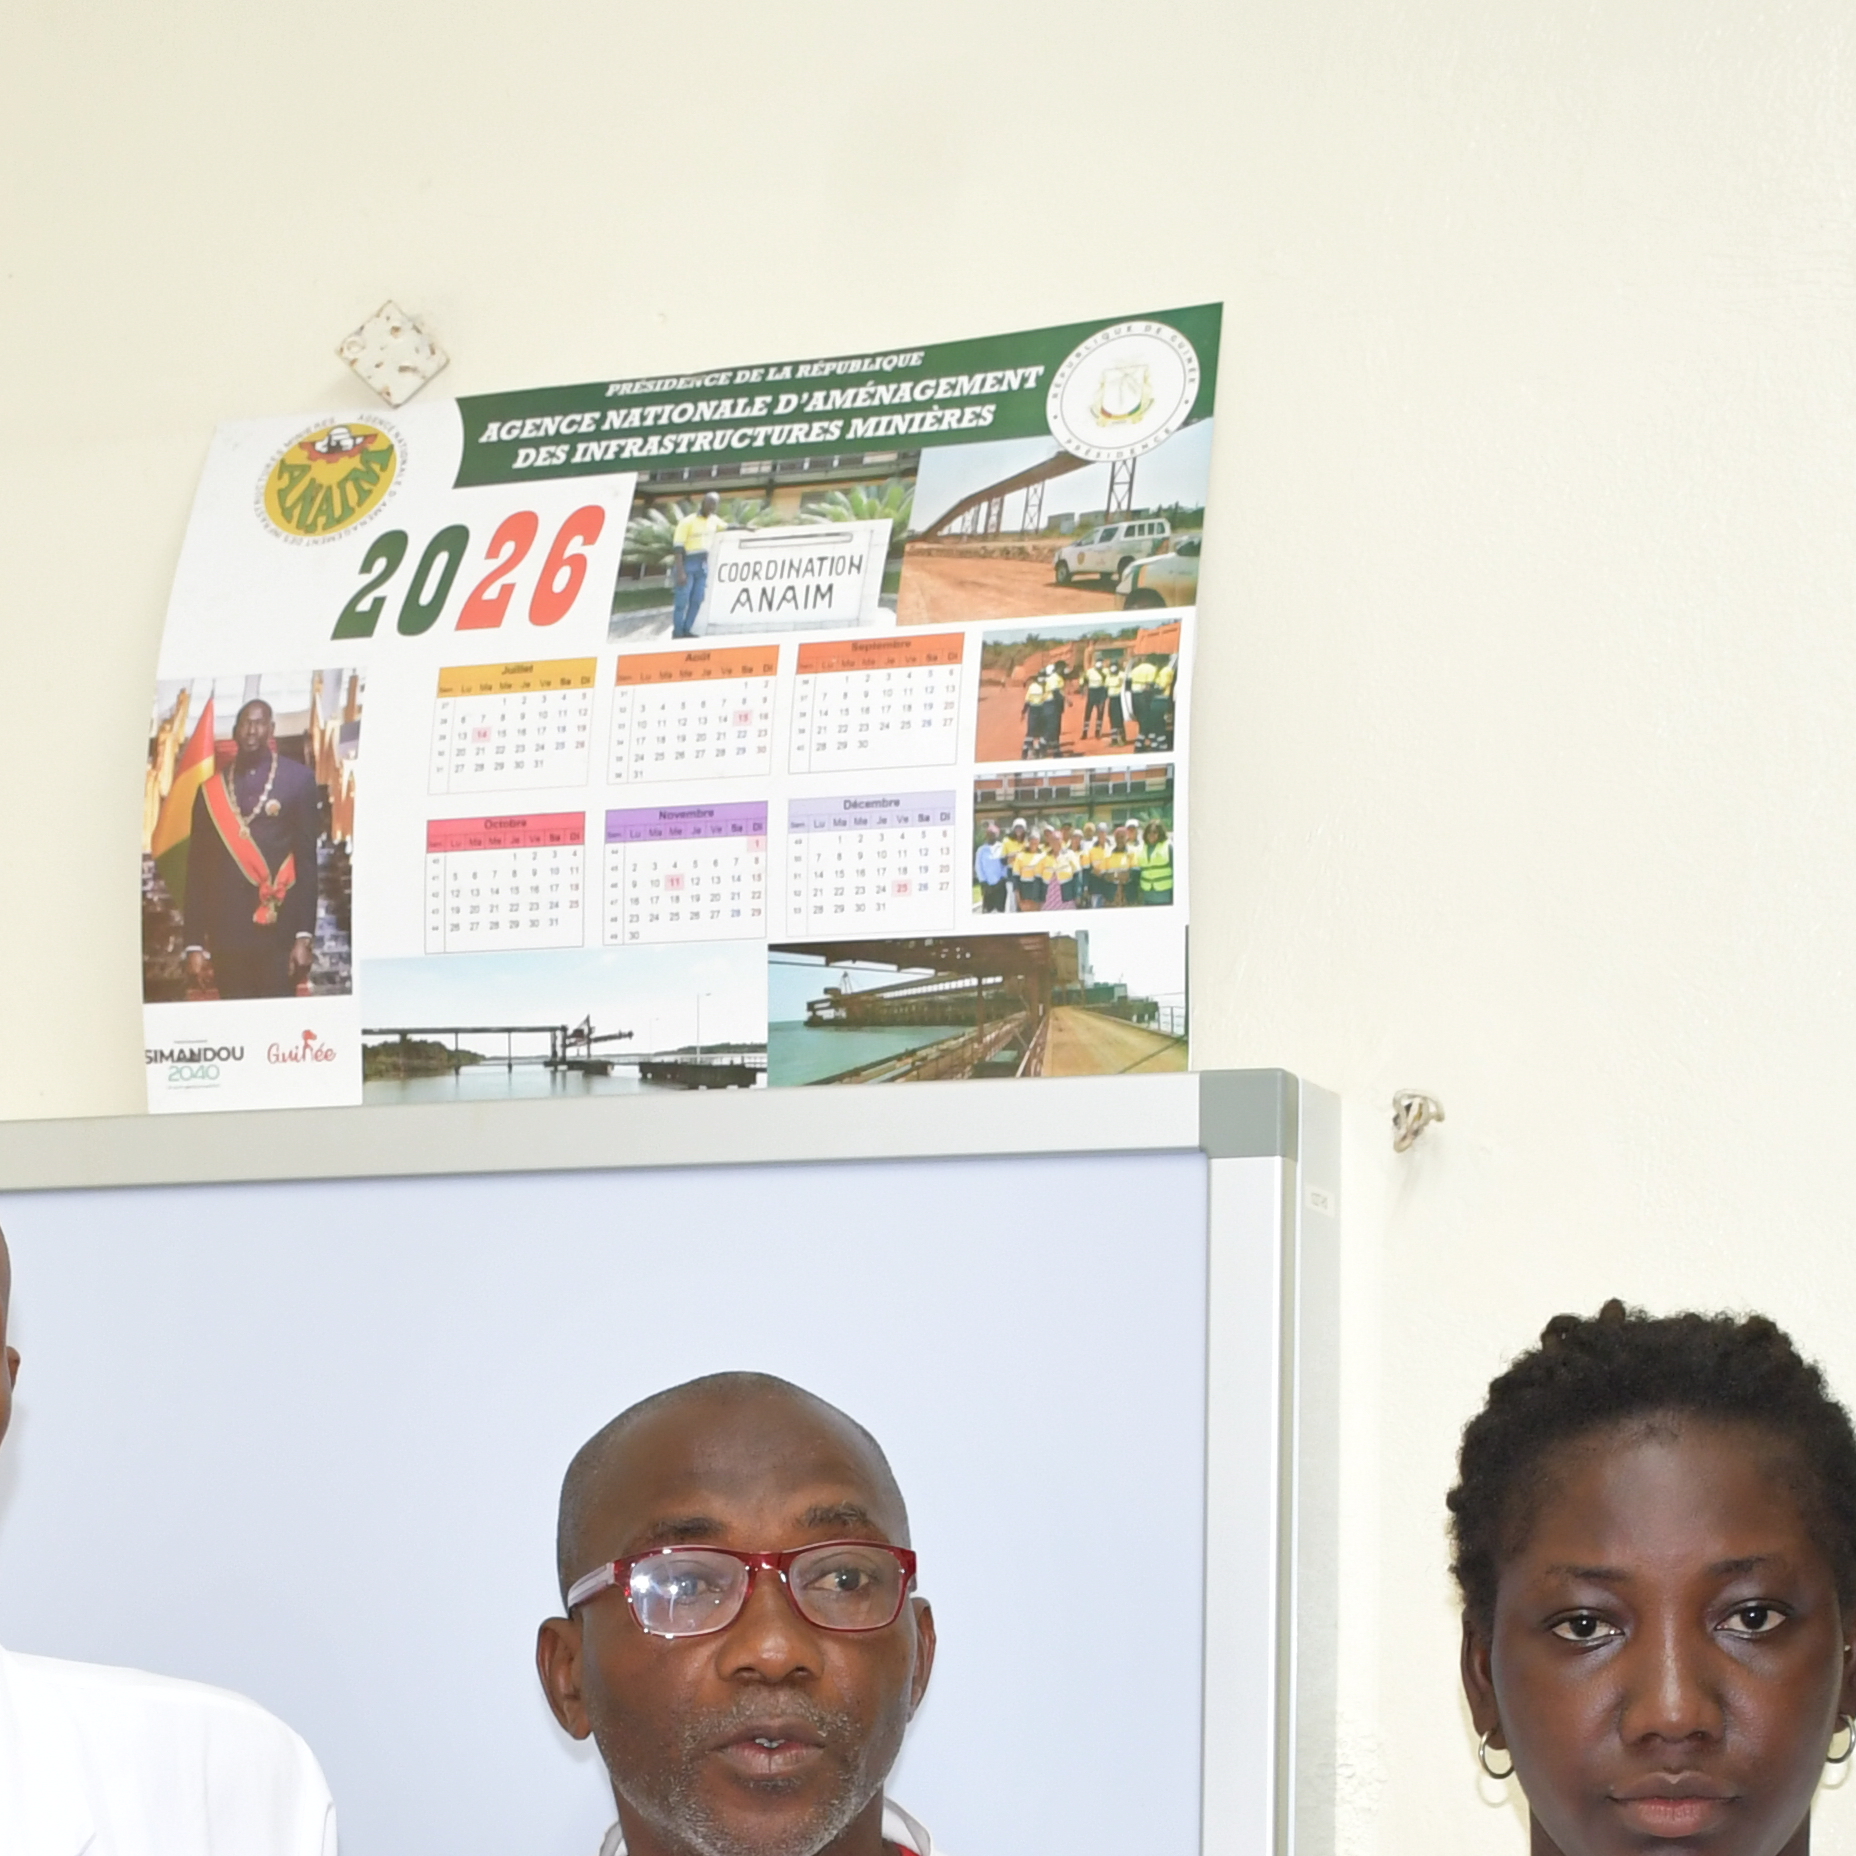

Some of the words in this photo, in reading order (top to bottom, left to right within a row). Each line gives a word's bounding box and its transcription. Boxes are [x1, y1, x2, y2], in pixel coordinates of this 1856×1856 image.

[605, 370, 732, 397] PRÉSIDENCE
[732, 368, 764, 384] DE
[765, 365, 792, 381] LA
[795, 351, 925, 379] RÉPUBLIQUE
[478, 411, 601, 443] AGENCE
[601, 395, 772, 431] NATIONALE
[773, 365, 1045, 415] D'AMÉNAGEMENT
[512, 444, 570, 469] DES
[570, 420, 844, 464] INFRASTRUCTURES
[845, 404, 997, 440] MINIÈRES
[277, 444, 394, 534] ANAIM
[330, 504, 605, 640] 2026
[717, 554, 864, 583] COORDINATION
[730, 583, 835, 614] ANAIM
[851, 640, 912, 653] Septembre
[685, 652, 712, 663] Août
[501, 664, 534, 676] Juillet
[843, 798, 900, 810] Décembre
[658, 808, 715, 820] Novembre
[484, 818, 527, 830] Octobre
[755, 839, 760, 848] 1
[838, 835, 842, 844] 1
[858, 834, 864, 844] 2
[900, 832, 905, 840] 4
[816, 852, 822, 862] 7
[857, 851, 864, 860] 9
[876, 850, 888, 859] 10
[898, 849, 907, 858] 11
[918, 847, 929, 857] 12
[940, 846, 950, 856] 13
[632, 863, 638, 872] 2
[734, 857, 739, 866] 7
[876, 867, 887, 876] 17
[632, 880, 638, 889] 9
[650, 878, 660, 888] 10
[670, 877, 680, 887] 11
[690, 876, 701, 886] 12
[711, 876, 721, 885] 13
[731, 874, 742, 882] 14
[813, 888, 823, 898] 21
[854, 886, 866, 896] 23
[876, 885, 886, 894] 24
[939, 881, 950, 891] 27
[650, 895, 660, 904] 17
[730, 892, 740, 901] 21
[876, 902, 886, 912] 31
[629, 914, 640, 924] 23
[649, 913, 660, 922] 24
[710, 909, 721, 920] 27
[469, 921, 480, 932] 27
[549, 918, 559, 927] 31
[145, 1046, 244, 1064] SIMANDOU
[267, 1036, 336, 1064] Guinée
[168, 1064, 220, 1082] 2040
